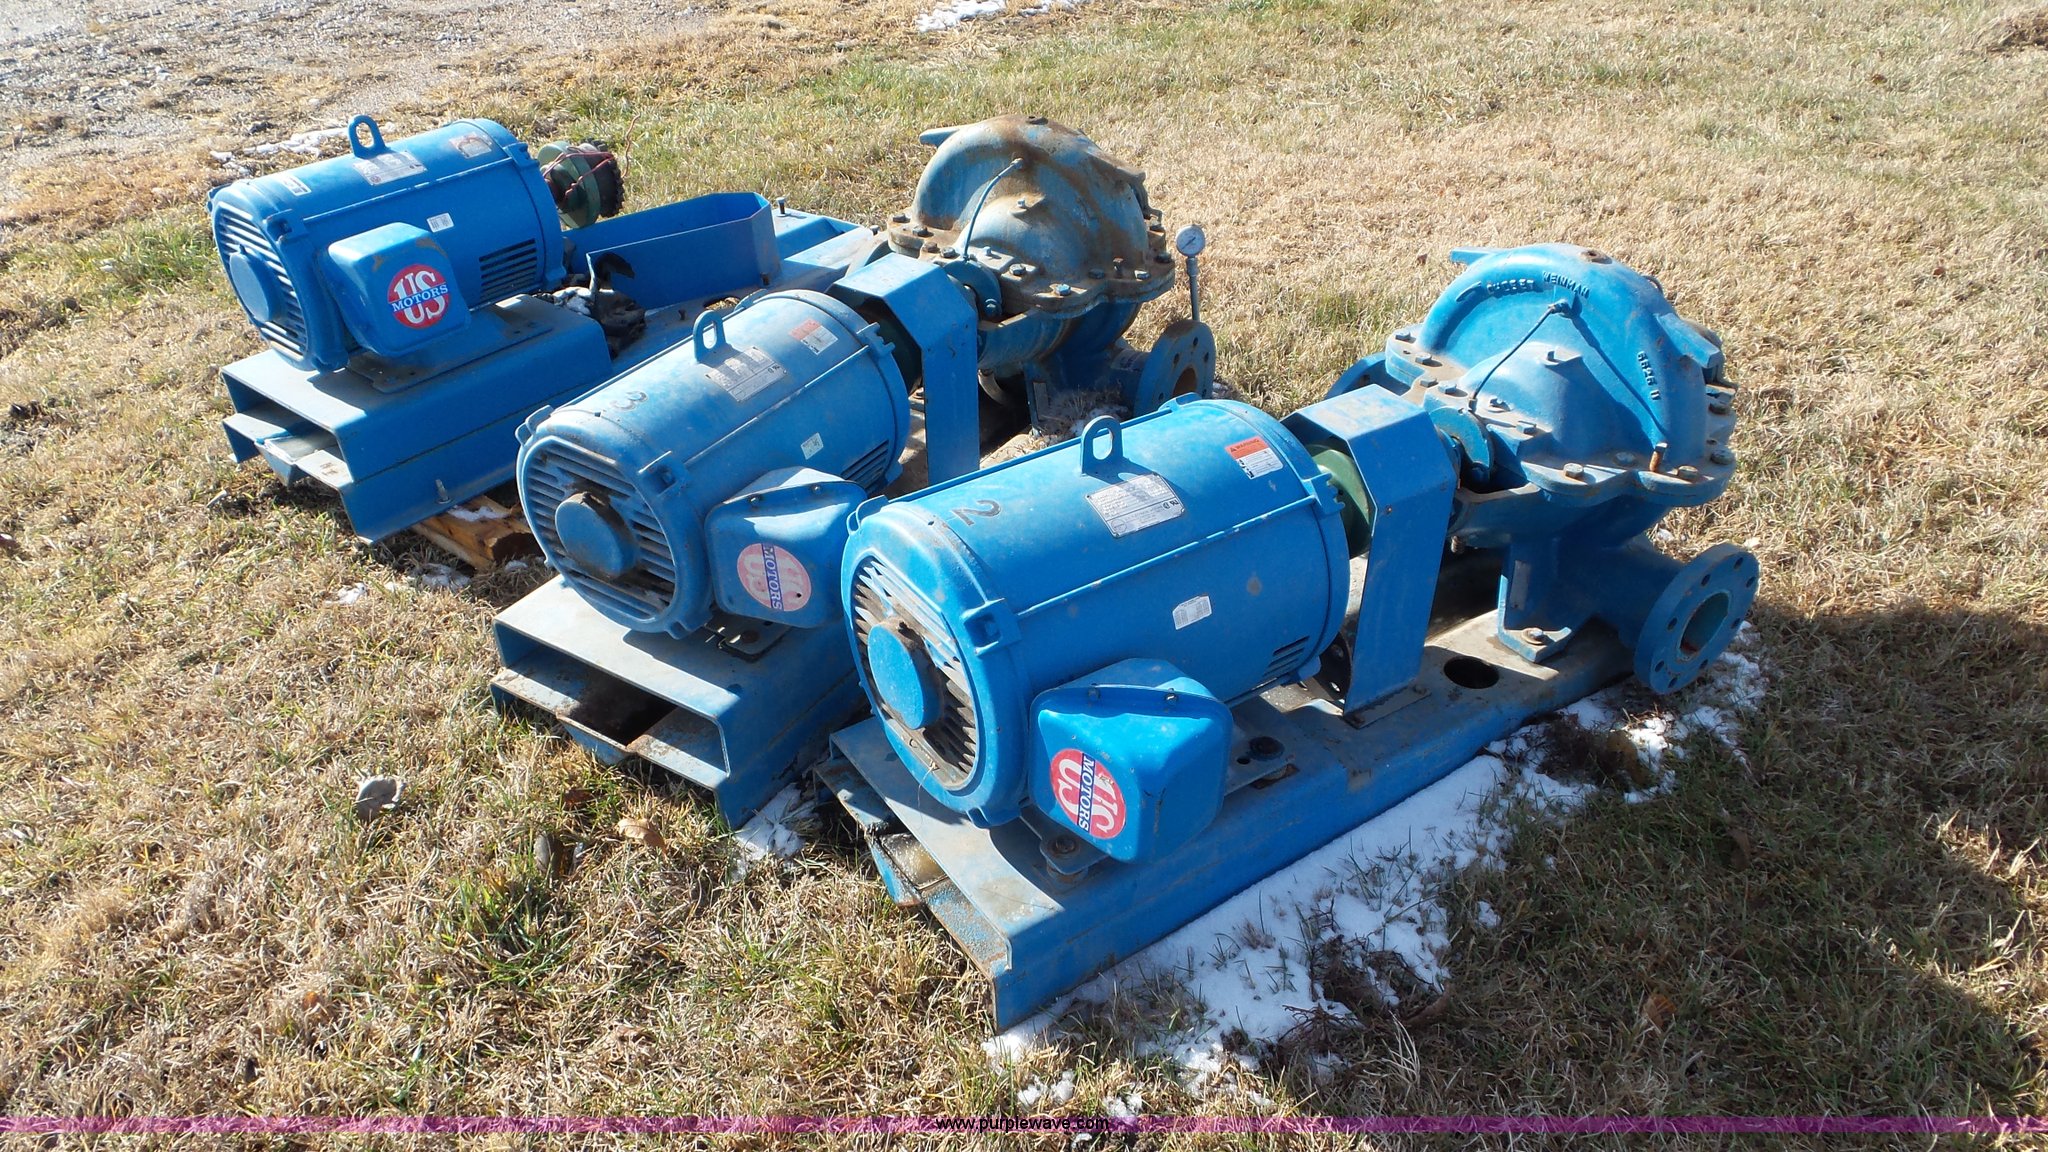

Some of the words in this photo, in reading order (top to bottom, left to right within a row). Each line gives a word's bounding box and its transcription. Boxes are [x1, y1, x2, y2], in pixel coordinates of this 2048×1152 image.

[391, 284, 448, 312] MOTORS
[1542, 270, 1590, 299] WEINMAN
[609, 390, 648, 411] 3
[950, 499, 1001, 526] 2
[1078, 756, 1096, 831] MOTORS
